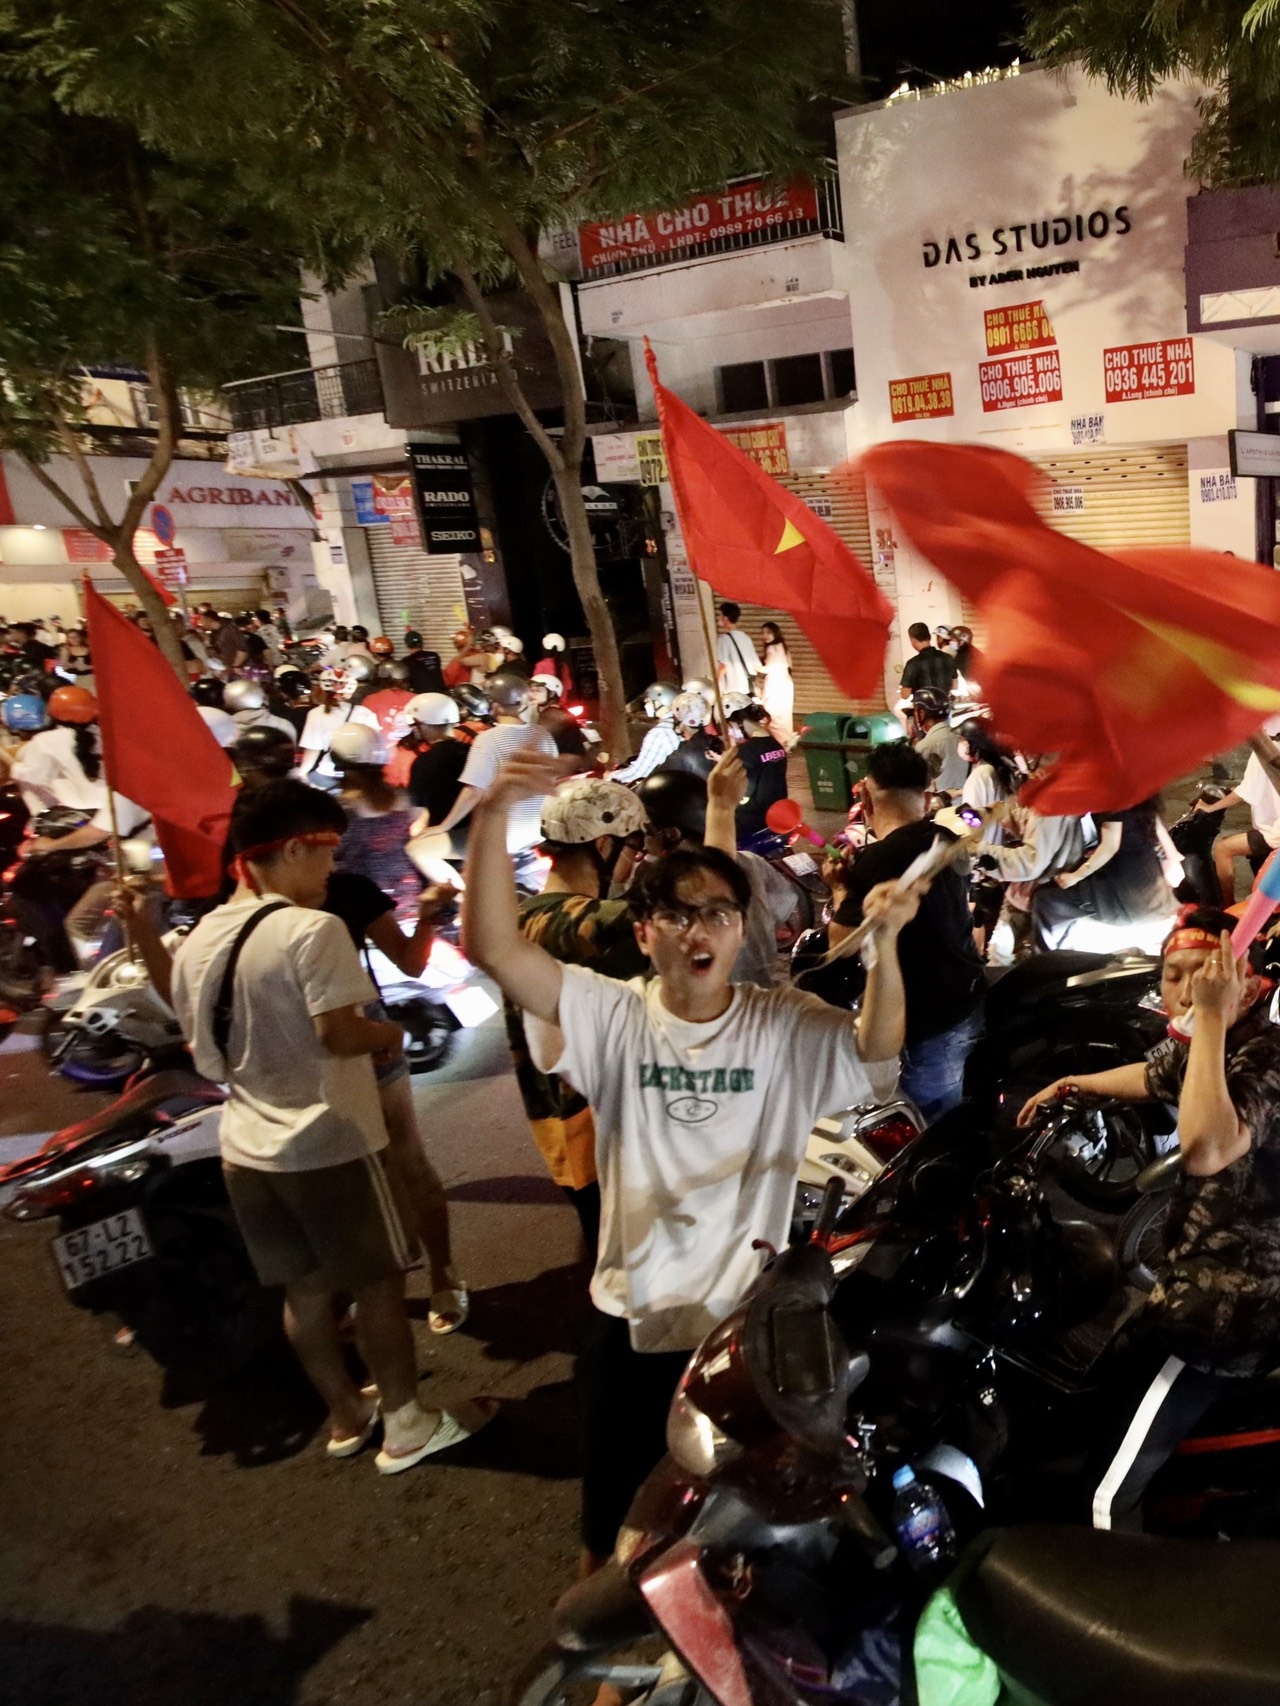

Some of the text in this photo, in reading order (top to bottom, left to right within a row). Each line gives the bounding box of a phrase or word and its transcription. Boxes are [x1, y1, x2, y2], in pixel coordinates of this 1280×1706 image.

[656, 203, 710, 236] CHO
[710, 221, 743, 240] 0989
[747, 218, 763, 232] 70
[766, 213, 783, 227] 66
[788, 208, 804, 222] 13
[923, 206, 1132, 268] DAS STUDIOS
[969, 275, 987, 288] BY
[986, 312, 1005, 327] CHO
[1007, 304, 1031, 323] THUÊ
[987, 325, 1011, 348] 0901
[1013, 319, 1039, 343] 6666
[981, 351, 1059, 381] CHO THUÊ NHÀ
[1105, 338, 1192, 369] CHO THUÊ NHÀ
[982, 370, 1062, 402] 0906.905.006
[1106, 359, 1193, 392] 0936 445 201
[891, 382, 908, 396] CHO
[892, 390, 952, 414] 0919.04.38.38
[414, 455, 468, 464] THAKRAL
[169, 486, 302, 506] AGRIBAN
[424, 491, 470, 502] RADO
[430, 530, 476, 541] SEIKO
